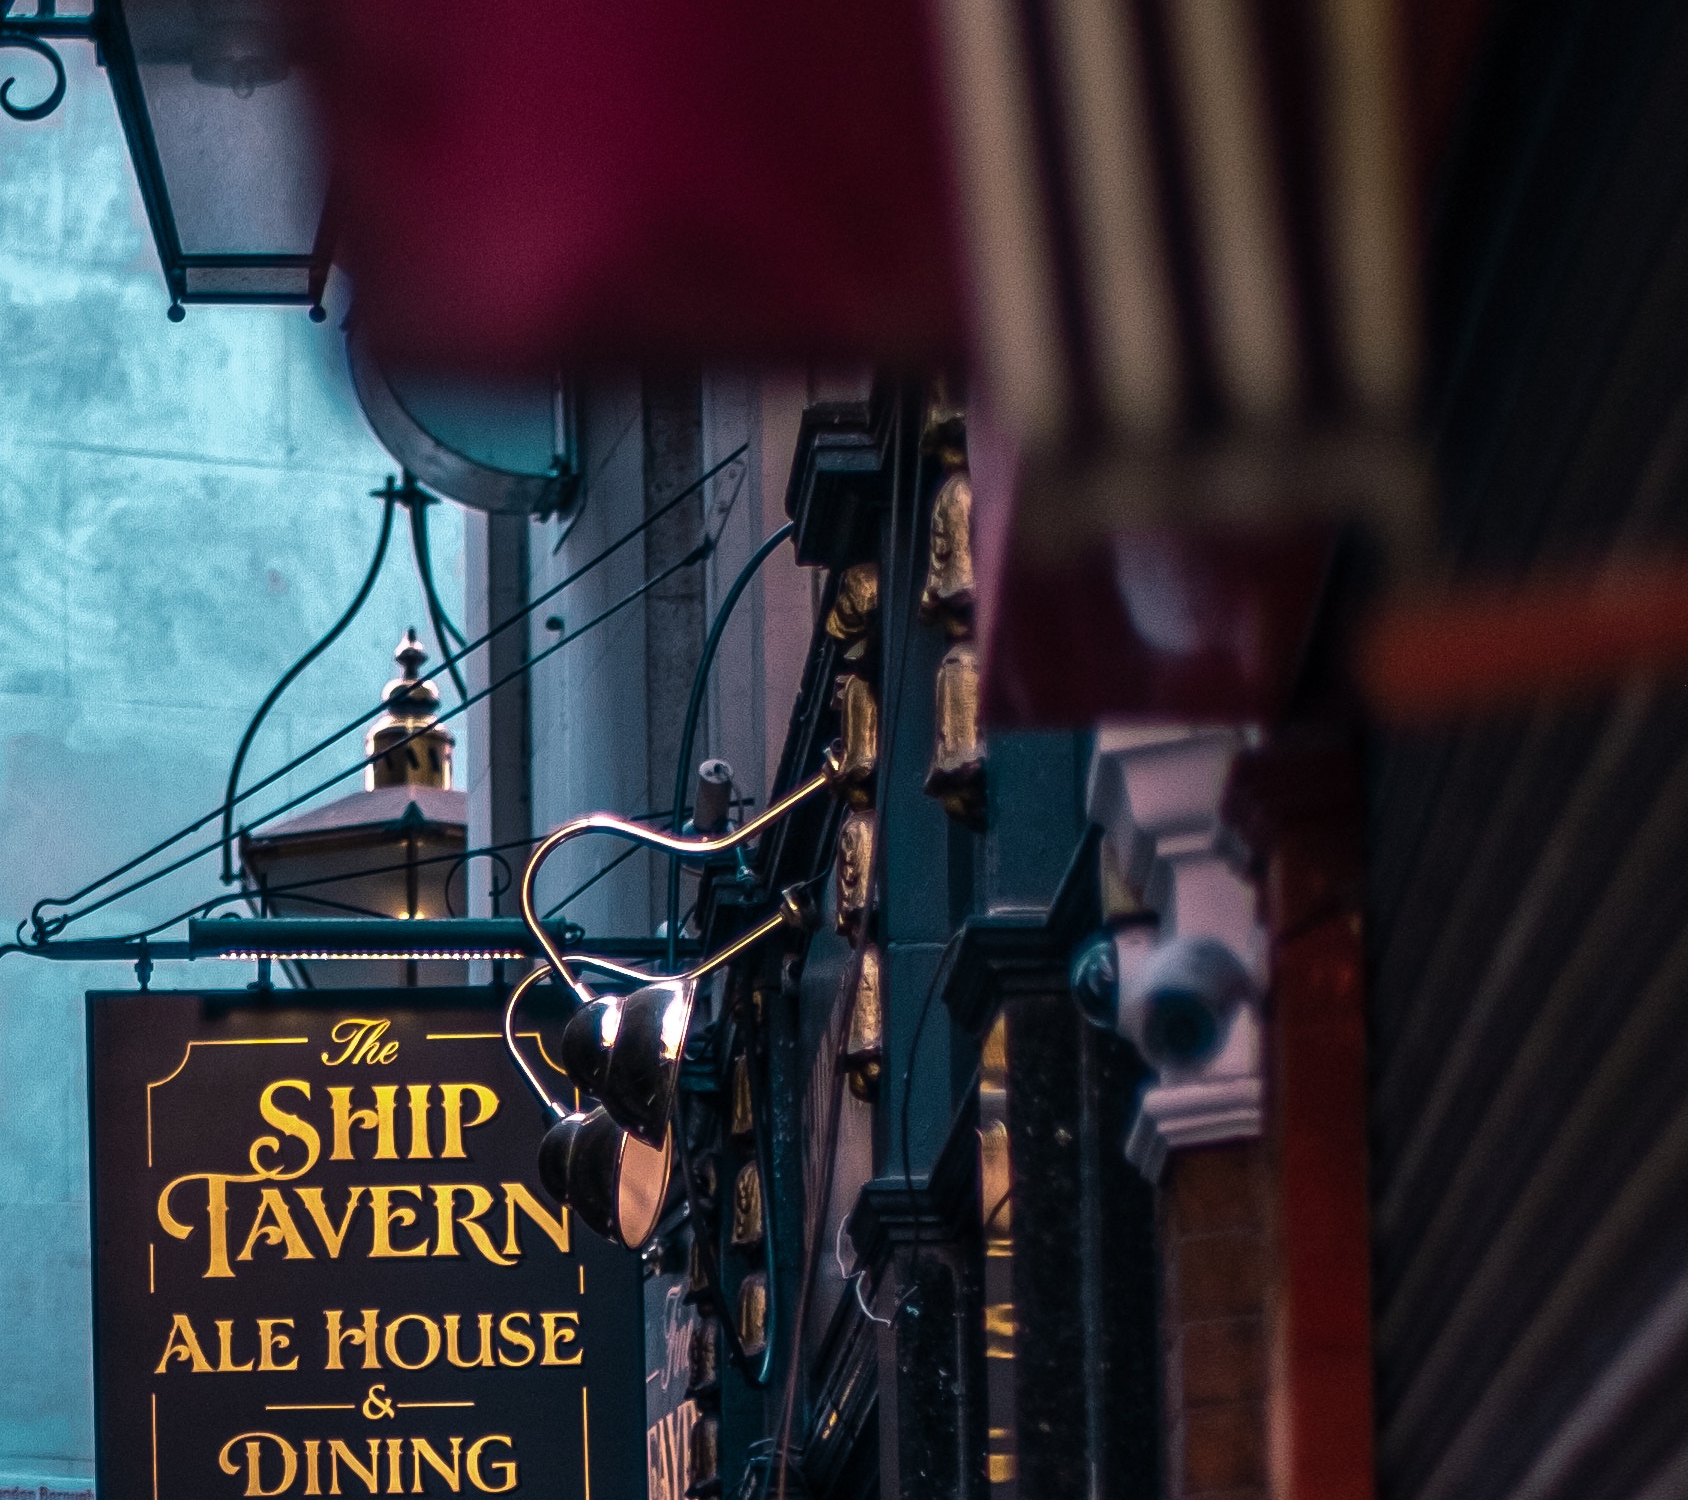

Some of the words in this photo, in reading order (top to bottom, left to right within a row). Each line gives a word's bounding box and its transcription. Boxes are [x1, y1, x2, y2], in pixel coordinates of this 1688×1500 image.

[322, 1018, 400, 1067] The
[249, 1079, 500, 1182] SHIP
[158, 1171, 571, 1279] TAVERN
[155, 1314, 300, 1375] ALE
[325, 1309, 585, 1371] HOUSE
[362, 1384, 395, 1421] &
[219, 1432, 518, 1498] DINING
